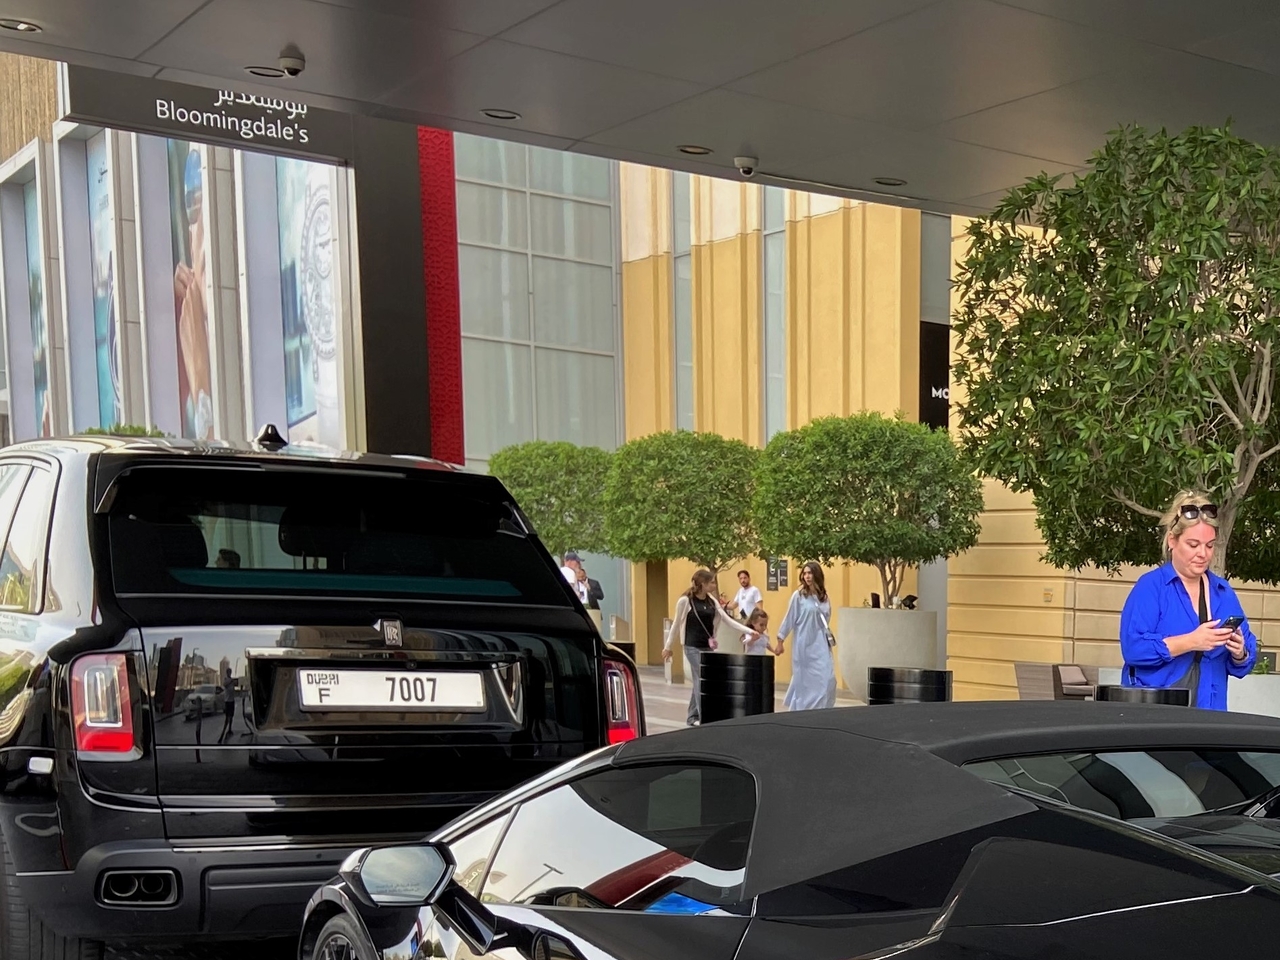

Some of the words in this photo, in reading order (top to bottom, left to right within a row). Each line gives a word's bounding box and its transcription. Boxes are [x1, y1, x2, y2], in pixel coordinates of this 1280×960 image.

[156, 99, 309, 143] Bloomingdale's
[318, 688, 330, 703] F
[385, 677, 437, 702] 7007
